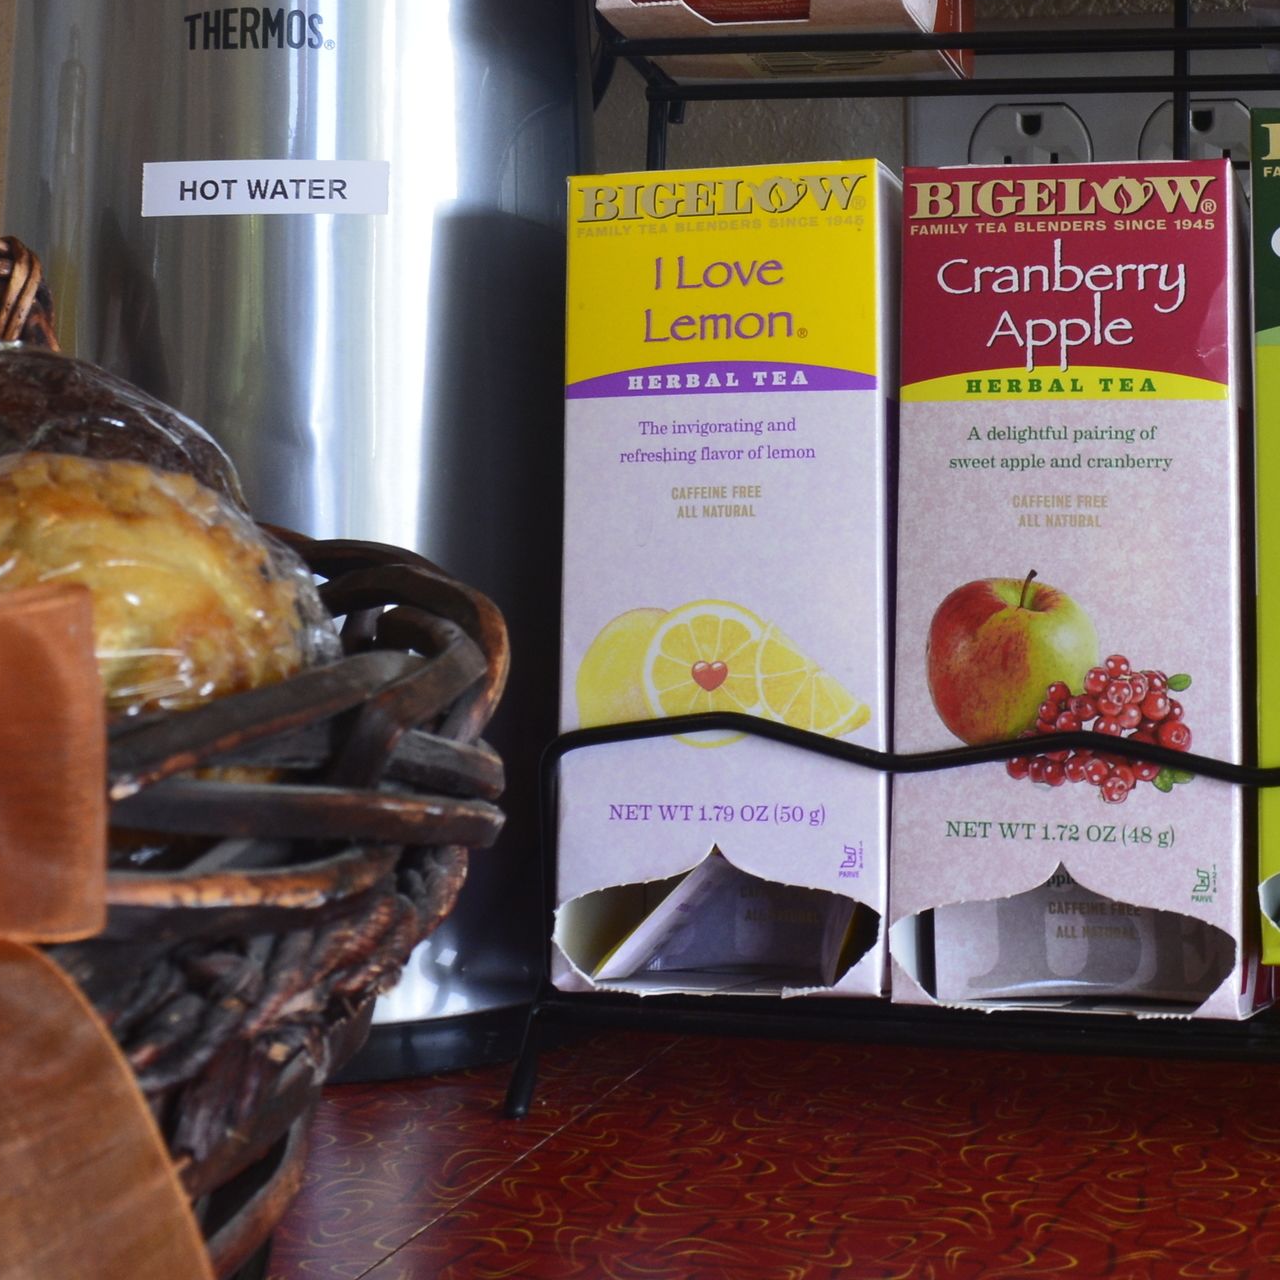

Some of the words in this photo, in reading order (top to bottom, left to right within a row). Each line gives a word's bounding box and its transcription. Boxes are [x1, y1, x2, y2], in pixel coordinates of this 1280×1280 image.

[184, 7, 323, 50] THERMOS
[180, 180, 237, 201] HOT
[247, 179, 347, 199] WATER
[577, 175, 866, 223] BIGELOW
[910, 176, 1216, 220] BIGELOW
[655, 257, 662, 290] I
[677, 256, 784, 289] Love
[937, 239, 1185, 313] Cranberry
[644, 309, 793, 342] Lemon
[987, 293, 1133, 372] Apple
[628, 373, 738, 390] HERBAL
[753, 371, 808, 385] TEA
[966, 379, 1083, 393] HERBAL
[1099, 378, 1156, 392] TEA
[639, 421, 668, 435] The
[672, 419, 763, 437] invigorating
[768, 417, 796, 431] and
[967, 426, 981, 440] A
[987, 426, 1067, 444] delightful
[1073, 426, 1135, 443] pairing
[1140, 426, 1157, 440] of
[620, 448, 696, 464] refreshing
[701, 447, 744, 460] flavor
[748, 445, 764, 459] of
[767, 445, 815, 459] lemon
[949, 456, 995, 468] sweet
[1001, 454, 1045, 471] apple
[1050, 454, 1081, 468] and
[1087, 454, 1172, 472] cranberry
